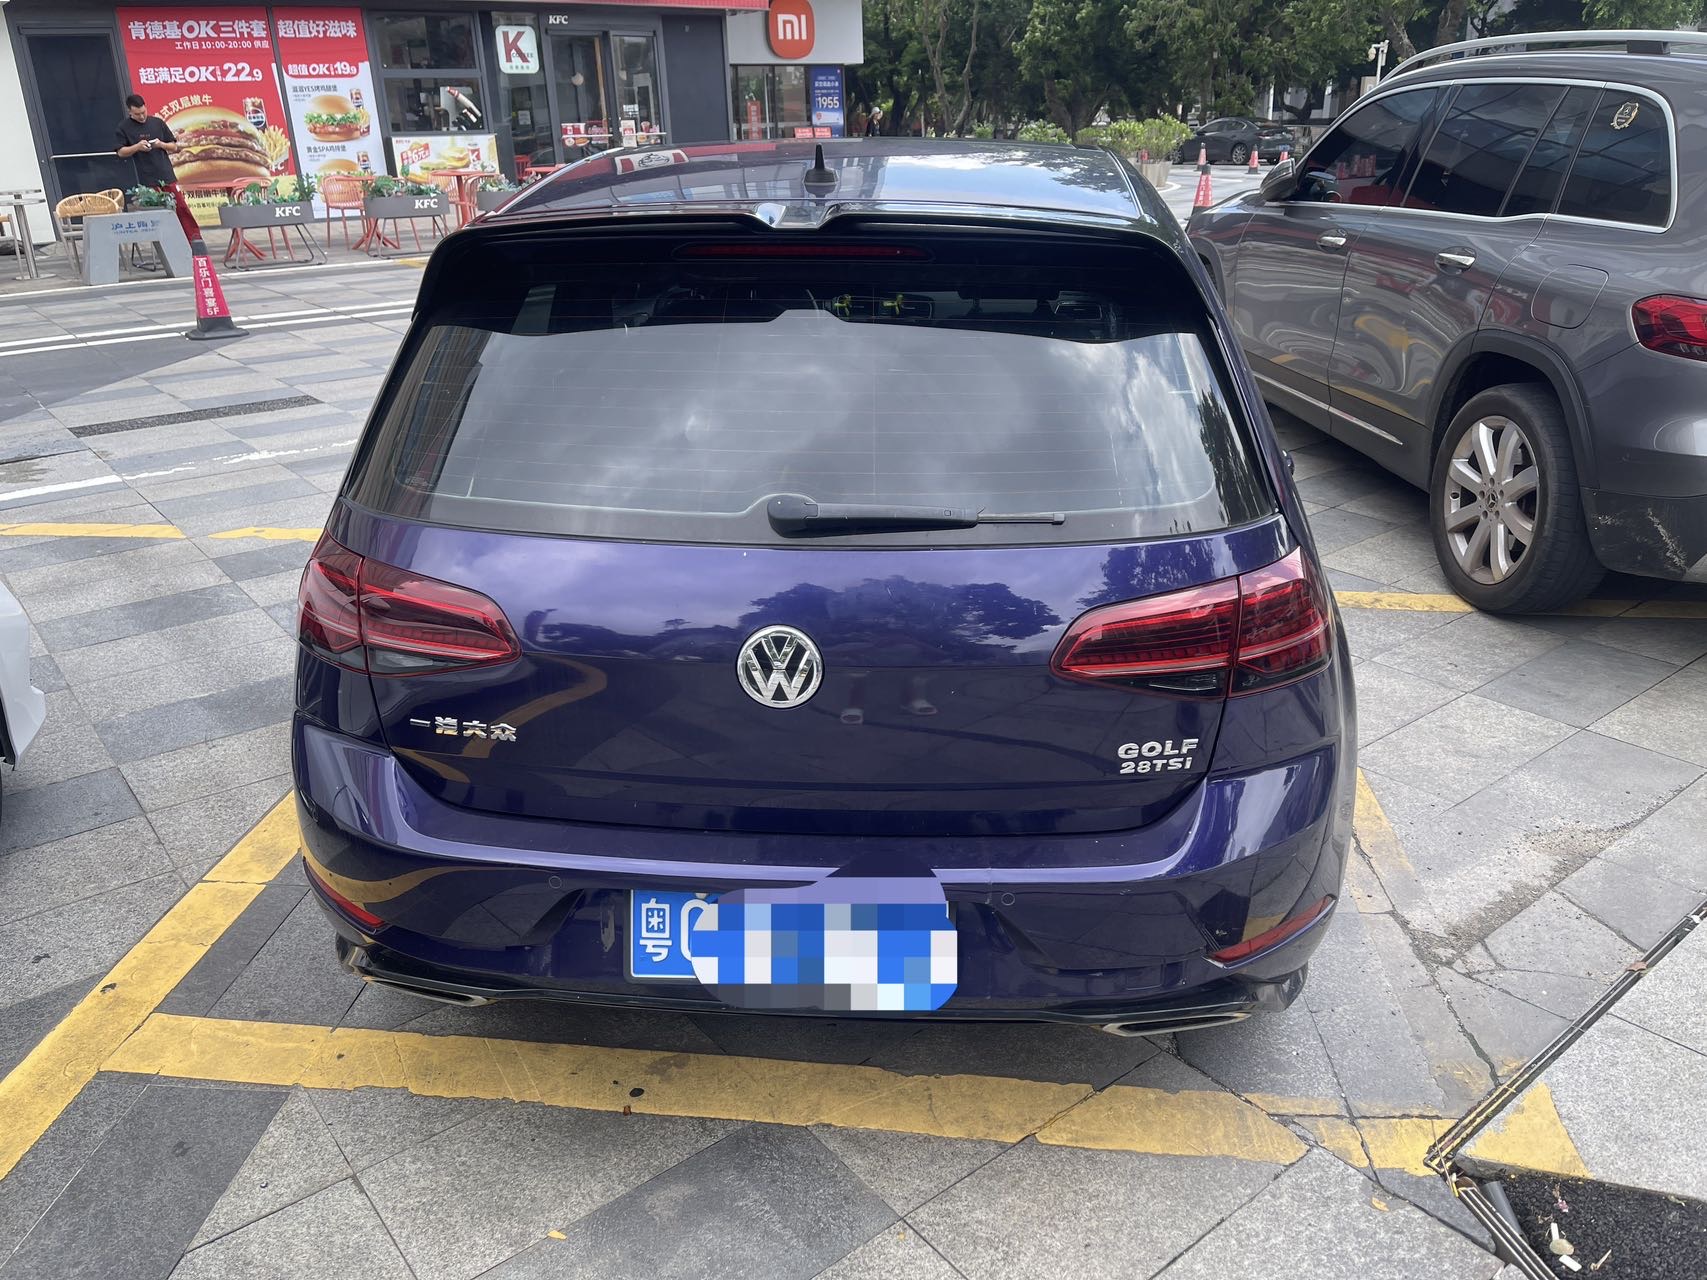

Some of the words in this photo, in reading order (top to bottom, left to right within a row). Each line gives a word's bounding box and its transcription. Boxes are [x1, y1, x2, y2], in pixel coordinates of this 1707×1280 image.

[277, 20, 357, 38] 超值好滋味
[549, 16, 569, 25] KFC
[128, 20, 267, 40] 肯德基OK三件套
[175, 42, 199, 50] 工作日
[201, 40, 252, 49] 10:00-20:00
[253, 40, 270, 48] 供应
[502, 31, 530, 63] K
[138, 66, 217, 84] 超满足OK
[288, 63, 330, 76] 超值OK
[275, 206, 301, 217] KFC
[414, 199, 438, 209] KFC
[1117, 738, 1199, 759] GOLF
[1119, 756, 1193, 775] 28TSI
